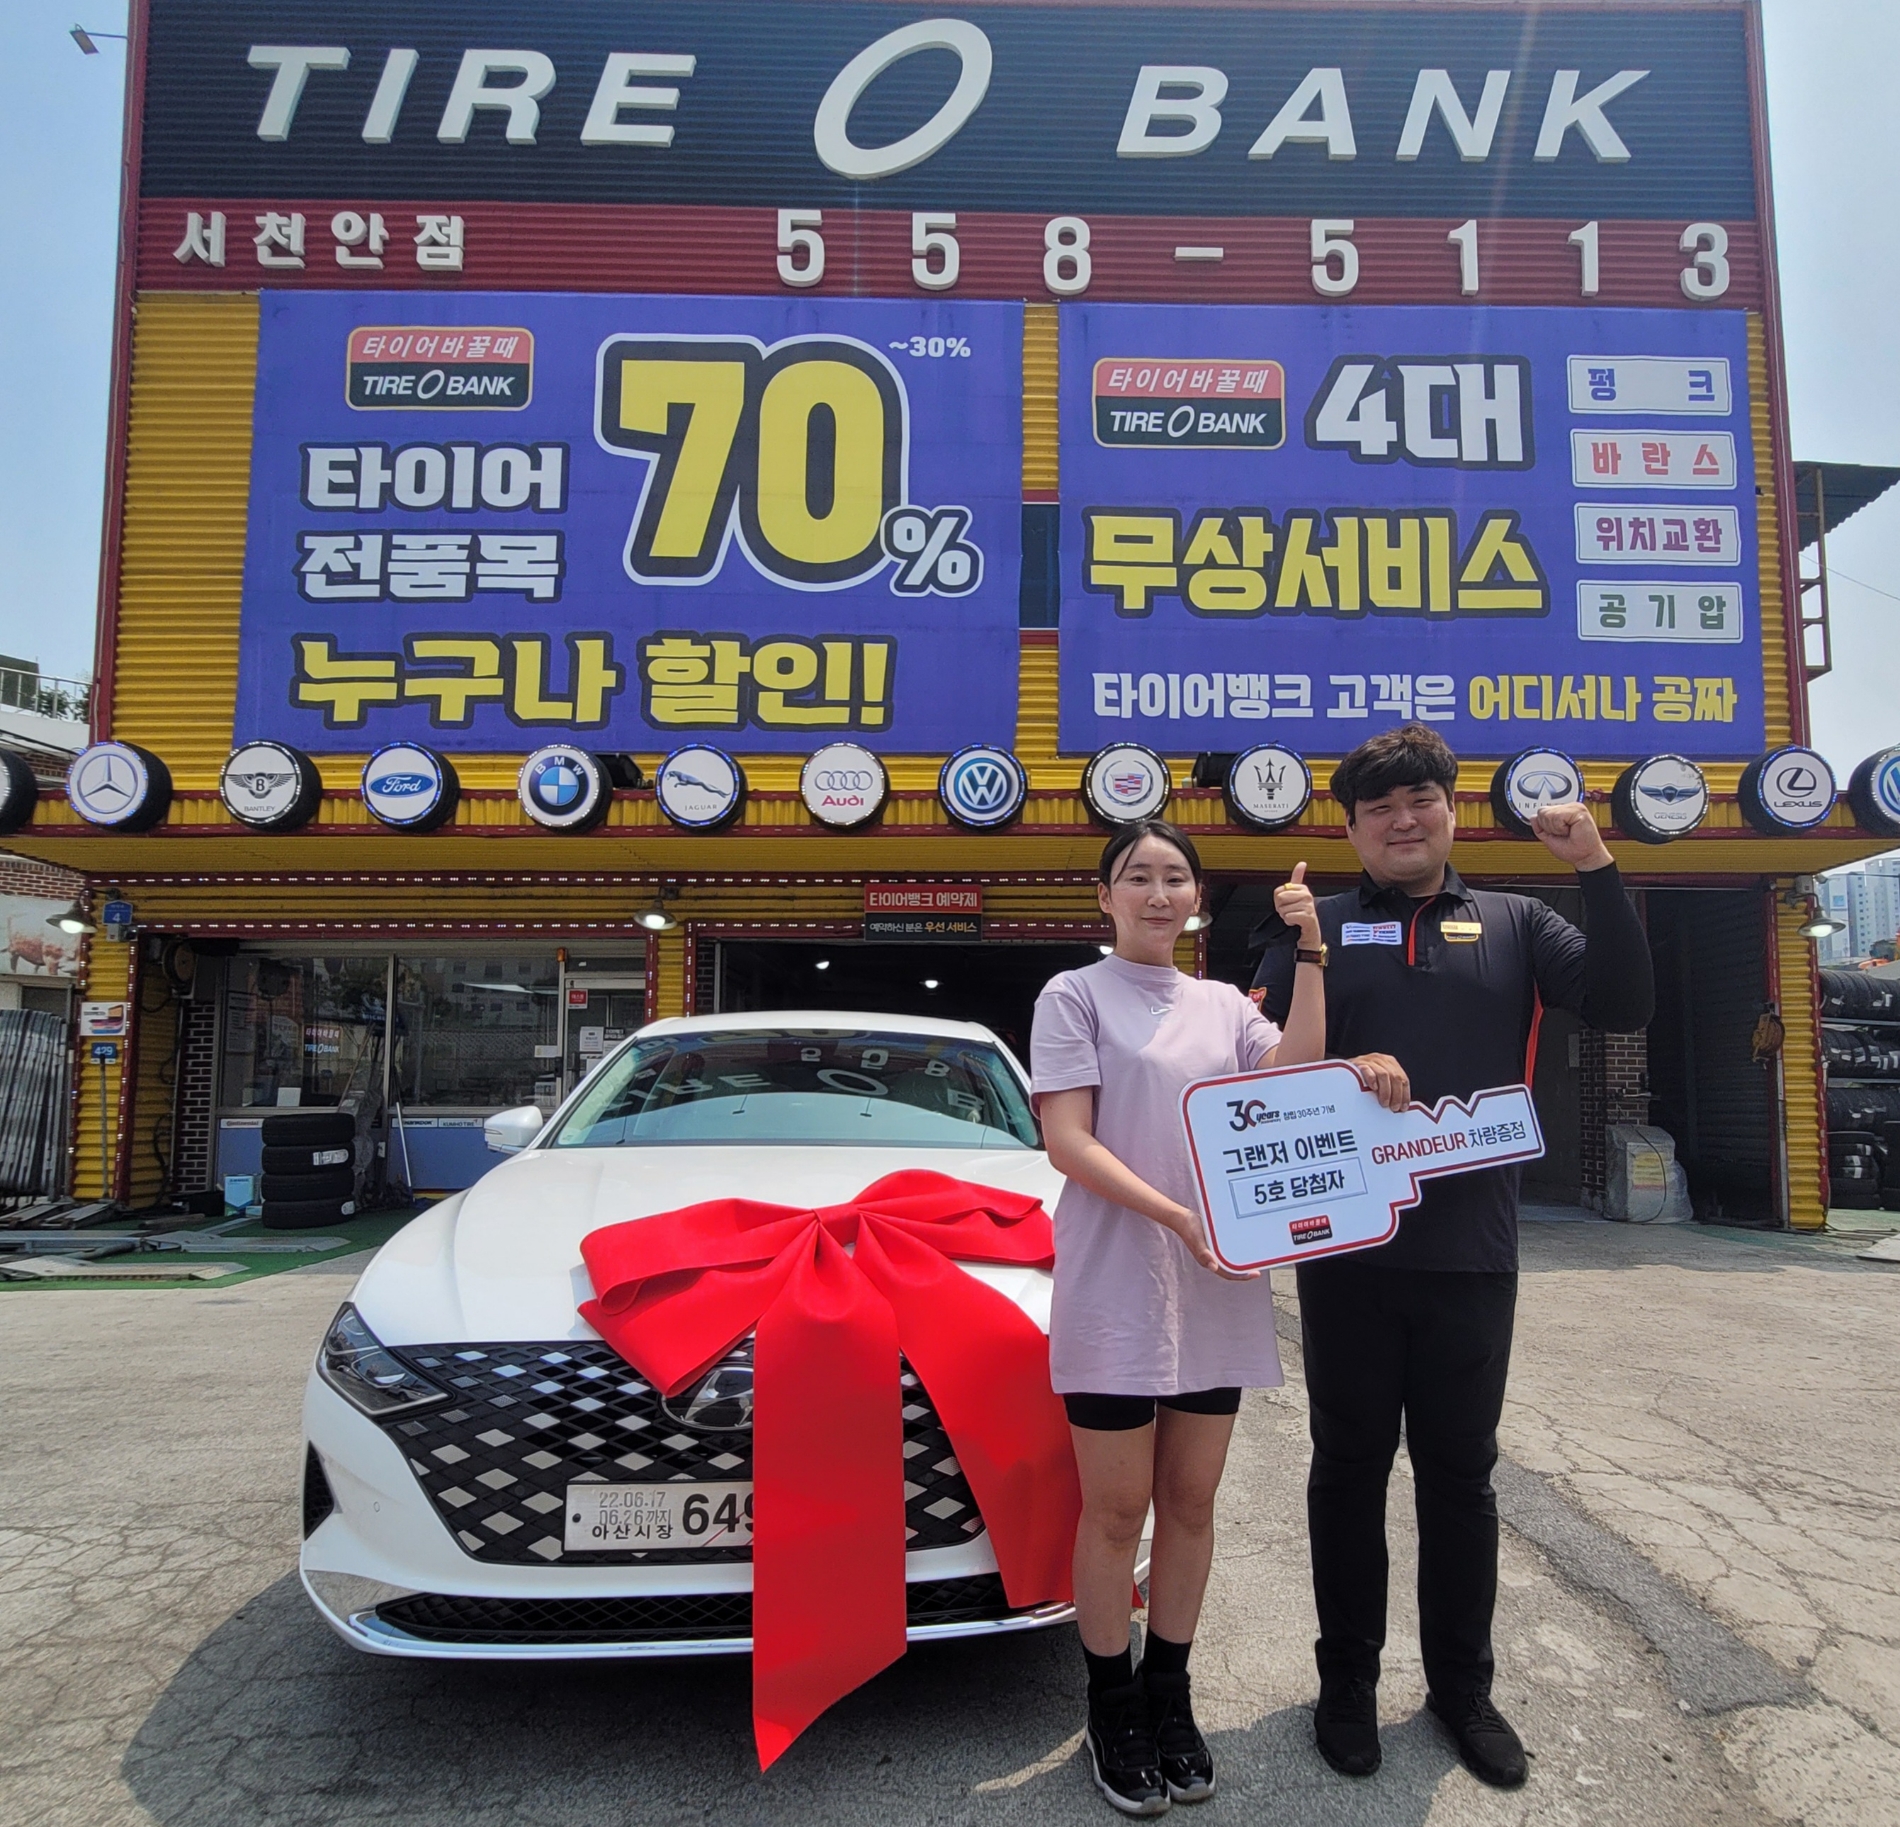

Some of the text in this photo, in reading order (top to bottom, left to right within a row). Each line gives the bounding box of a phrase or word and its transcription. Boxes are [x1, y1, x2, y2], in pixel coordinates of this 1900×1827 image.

[246, 18, 1651, 180] TIRE O BANK
[173, 210, 466, 272] 서천안점
[776, 209, 1730, 301] 558-5113
[363, 375, 416, 396] TIRE
[446, 376, 516, 396] BANK
[1110, 411, 1165, 432] TIRE
[1197, 412, 1268, 434] BANK
[1313, 362, 1525, 463] 4대
[304, 445, 565, 511] 타이어
[1594, 516, 1724, 554] 위치교환
[301, 532, 560, 600] 전품목
[1089, 513, 1545, 613] 무상서비스
[1598, 593, 1727, 631] 공기압
[296, 635, 895, 726] 누구나 할인!
[1092, 671, 1739, 724] 타이어뱅크 고객은 어디서나 공짜
[382, 775, 422, 793] Ford
[535, 756, 584, 776] BMW
[684, 804, 718, 812] JAGUAR
[821, 794, 864, 806] Audi
[1773, 800, 1823, 808] LEXUS
[869, 892, 978, 907] 타이어뱅크 예약제
[946, 922, 978, 933] 서비스
[1297, 1106, 1320, 1119] 30주년
[1222, 1128, 1359, 1174] 그랜저 이벤트
[1370, 1119, 1527, 1166] GRANDEUR 차량증정
[1253, 1168, 1346, 1206] 5호 당첨자
[592, 1523, 674, 1540] 아산시장
